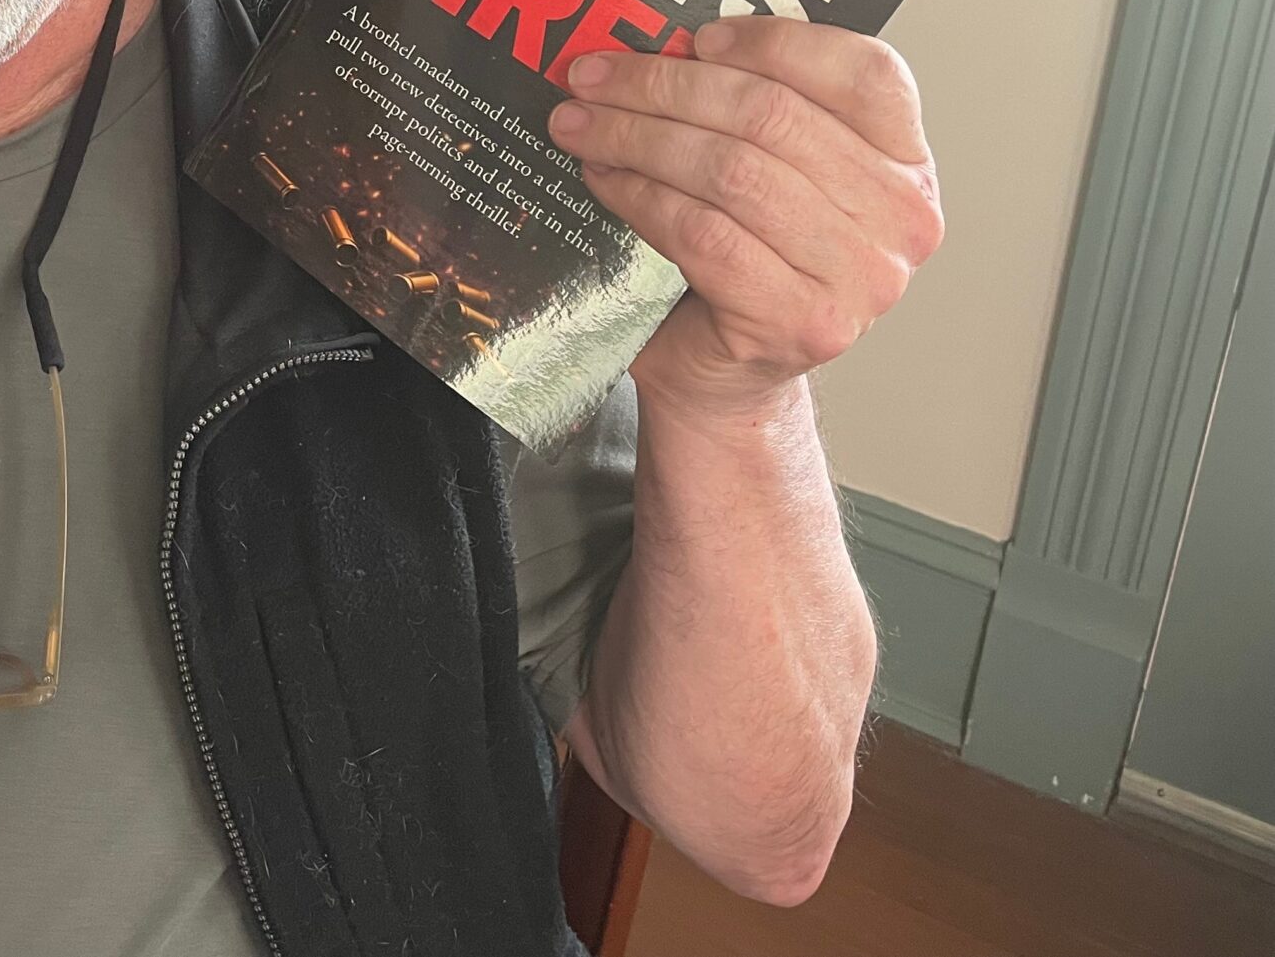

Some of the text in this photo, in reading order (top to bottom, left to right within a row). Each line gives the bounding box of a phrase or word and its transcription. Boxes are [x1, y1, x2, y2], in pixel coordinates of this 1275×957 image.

[326, 29, 362, 55] pull
[360, 51, 389, 76] two
[391, 72, 424, 99] new
[424, 94, 498, 153] detectives
[498, 145, 532, 177] into
[533, 174, 544, 186] a
[546, 180, 599, 226] deadly
[335, 65, 597, 257] of corrupt politics and deceit in this
[342, 5, 583, 182] A brothel madam and three othe
[367, 124, 520, 239] page-turning thriller.
